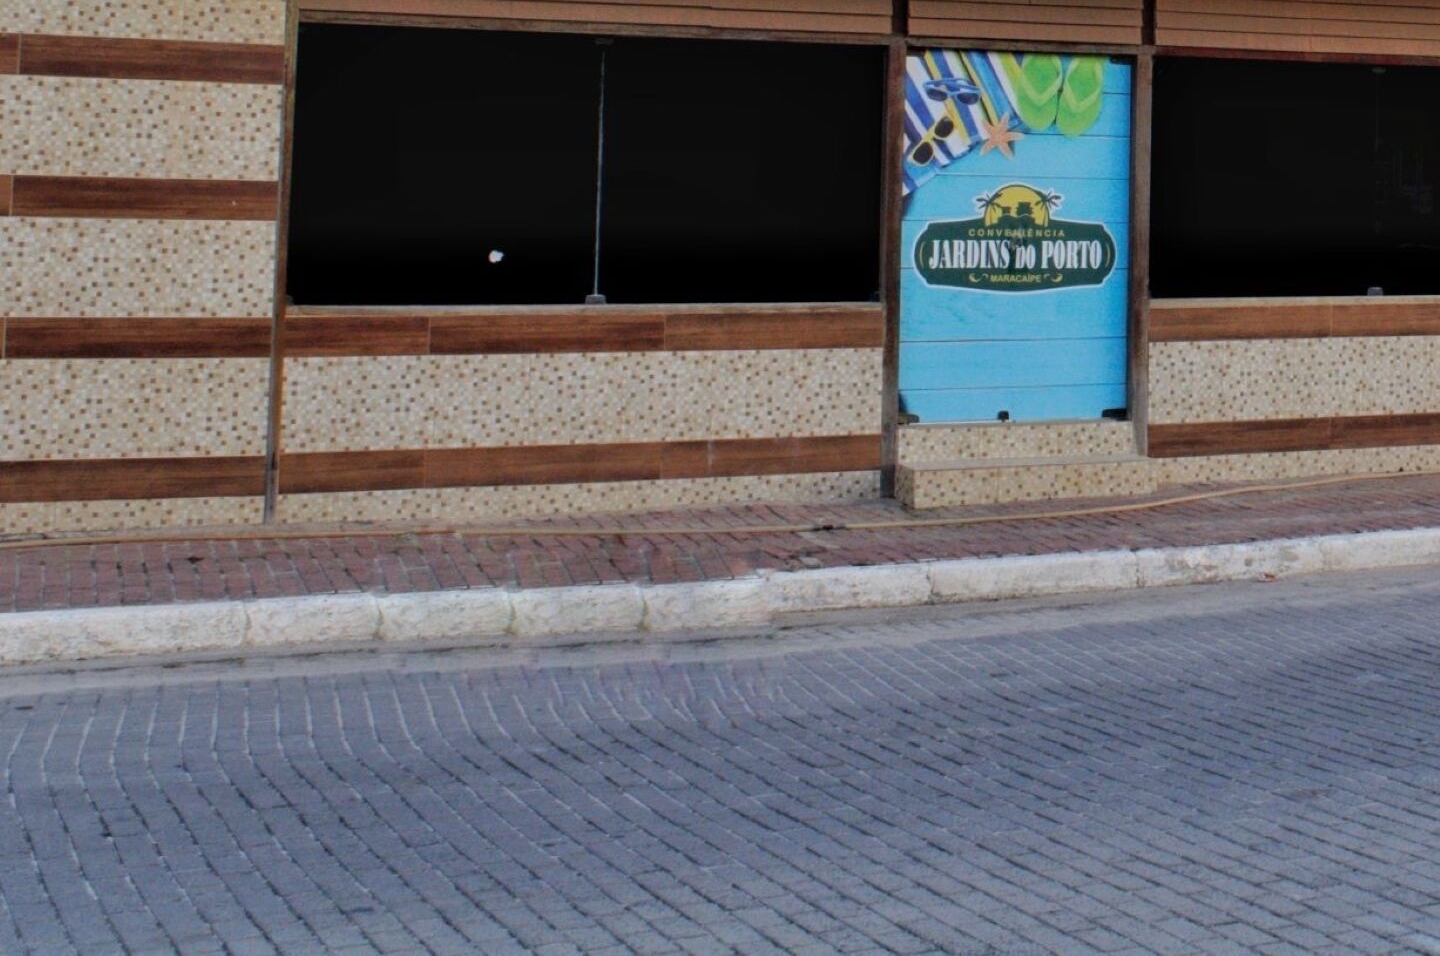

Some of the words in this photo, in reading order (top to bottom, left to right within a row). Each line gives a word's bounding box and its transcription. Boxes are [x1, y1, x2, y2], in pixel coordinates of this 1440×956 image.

[928, 239, 1011, 270] JARDINS
[1015, 244, 1036, 270] DO
[1041, 239, 1103, 270] PORTO
